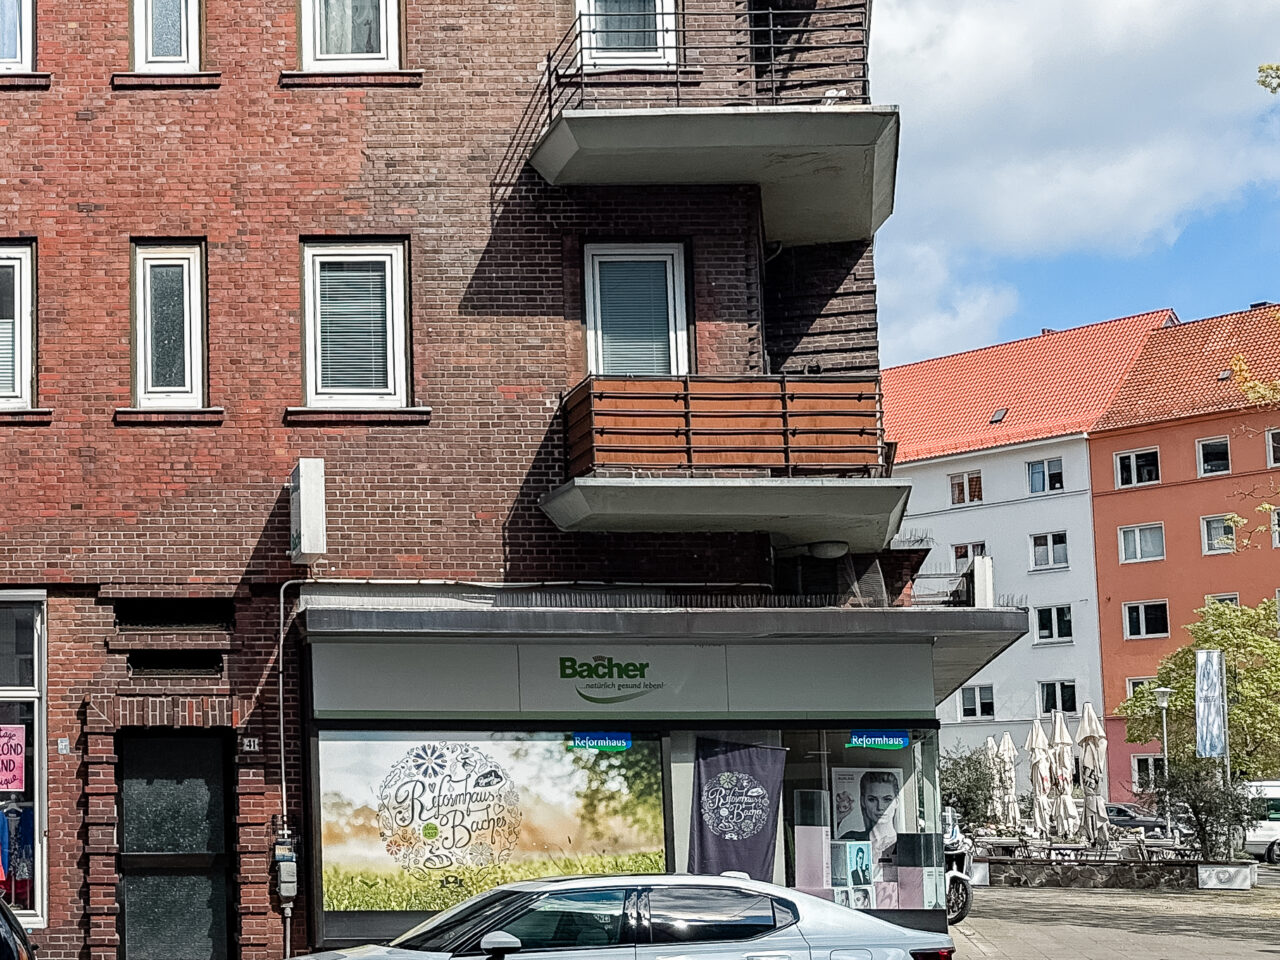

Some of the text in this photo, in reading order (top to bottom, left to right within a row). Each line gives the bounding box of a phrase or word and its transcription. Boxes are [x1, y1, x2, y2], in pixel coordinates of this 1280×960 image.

[559, 655, 650, 679] Bacher
[617, 682, 642, 691] gesund
[642, 681, 664, 689] leben!
[246, 739, 256, 750] 41
[574, 736, 627, 749] Reformhaus
[851, 734, 904, 748] Reformhaus
[394, 774, 495, 827] Reformhaus
[708, 786, 762, 809] Reformhaus
[439, 803, 507, 850] Bacher
